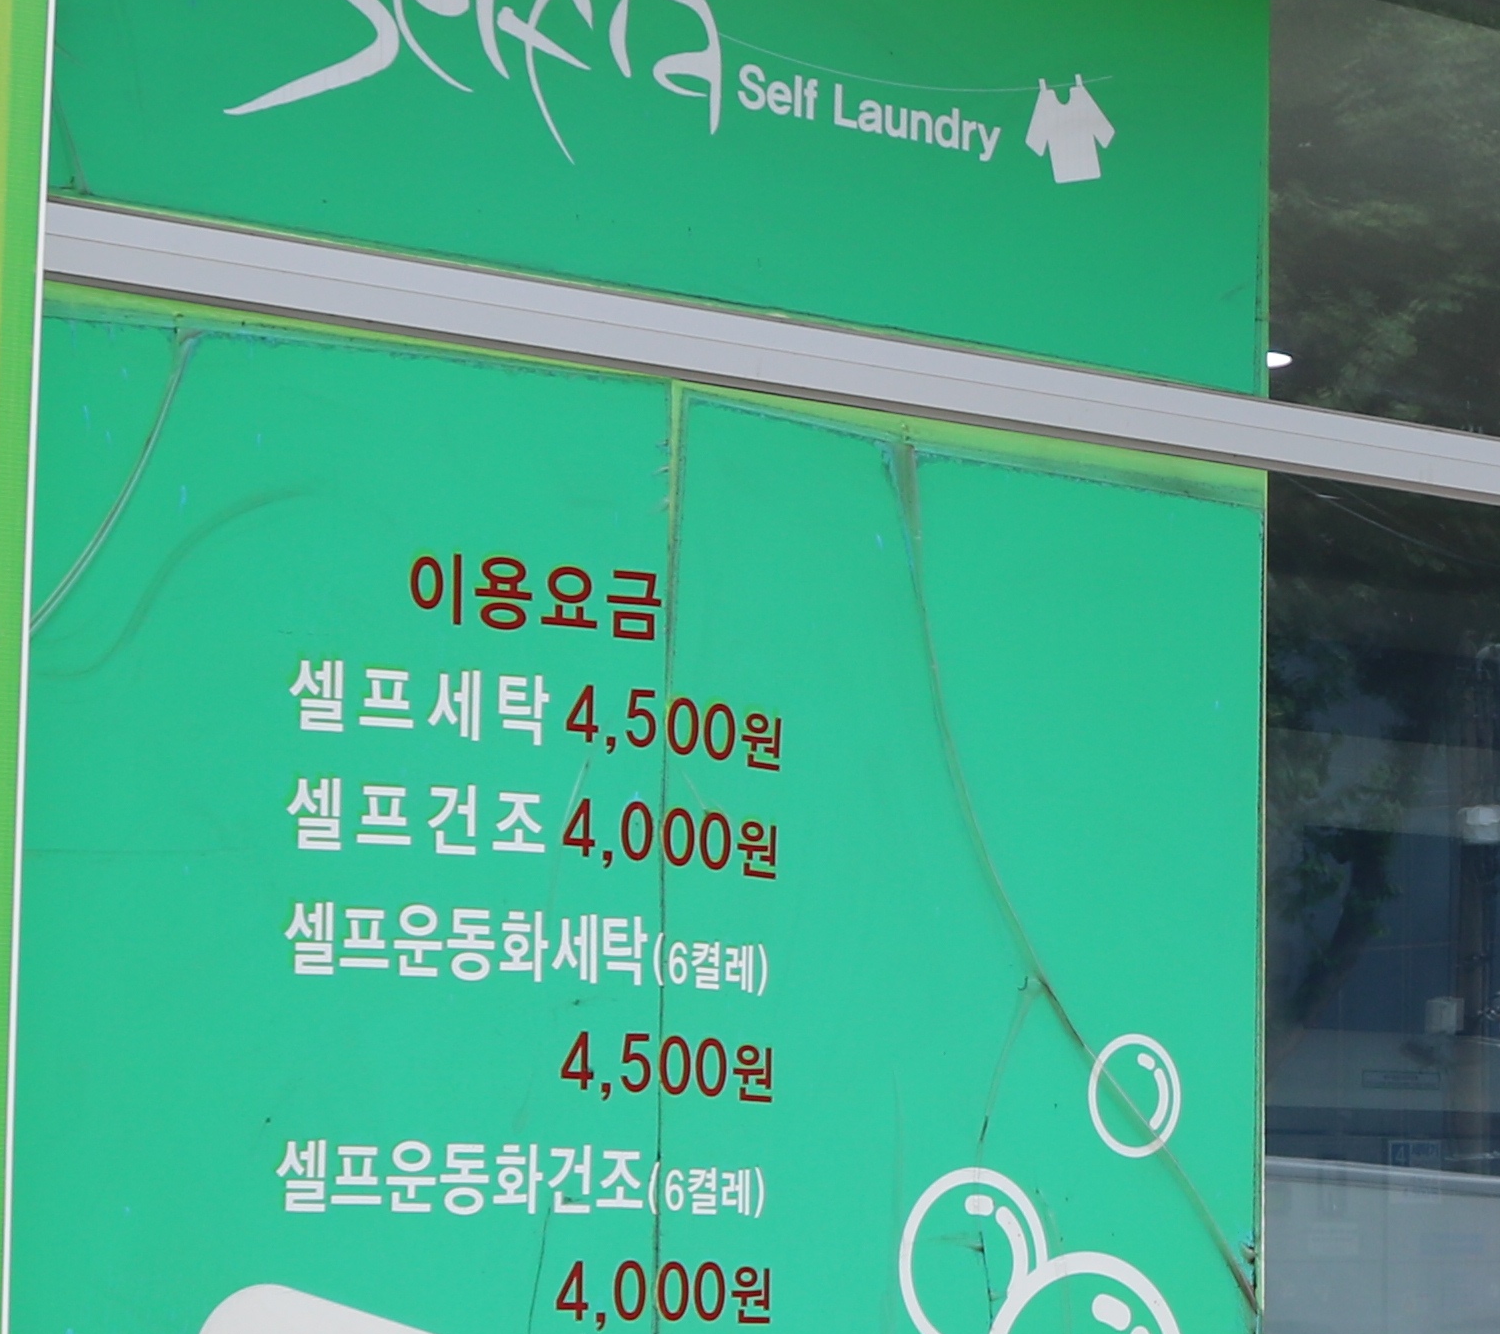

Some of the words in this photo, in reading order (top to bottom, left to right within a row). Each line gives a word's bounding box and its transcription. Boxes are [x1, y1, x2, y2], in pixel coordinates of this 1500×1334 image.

[737, 63, 819, 121] Self
[834, 82, 1002, 162] Laundry
[409, 553, 664, 642] 이용요금
[565, 683, 784, 773] 4,500원
[562, 797, 780, 881] 4,000원
[560, 1030, 775, 1105] 4,500원
[555, 1259, 773, 1332] 4,000원
